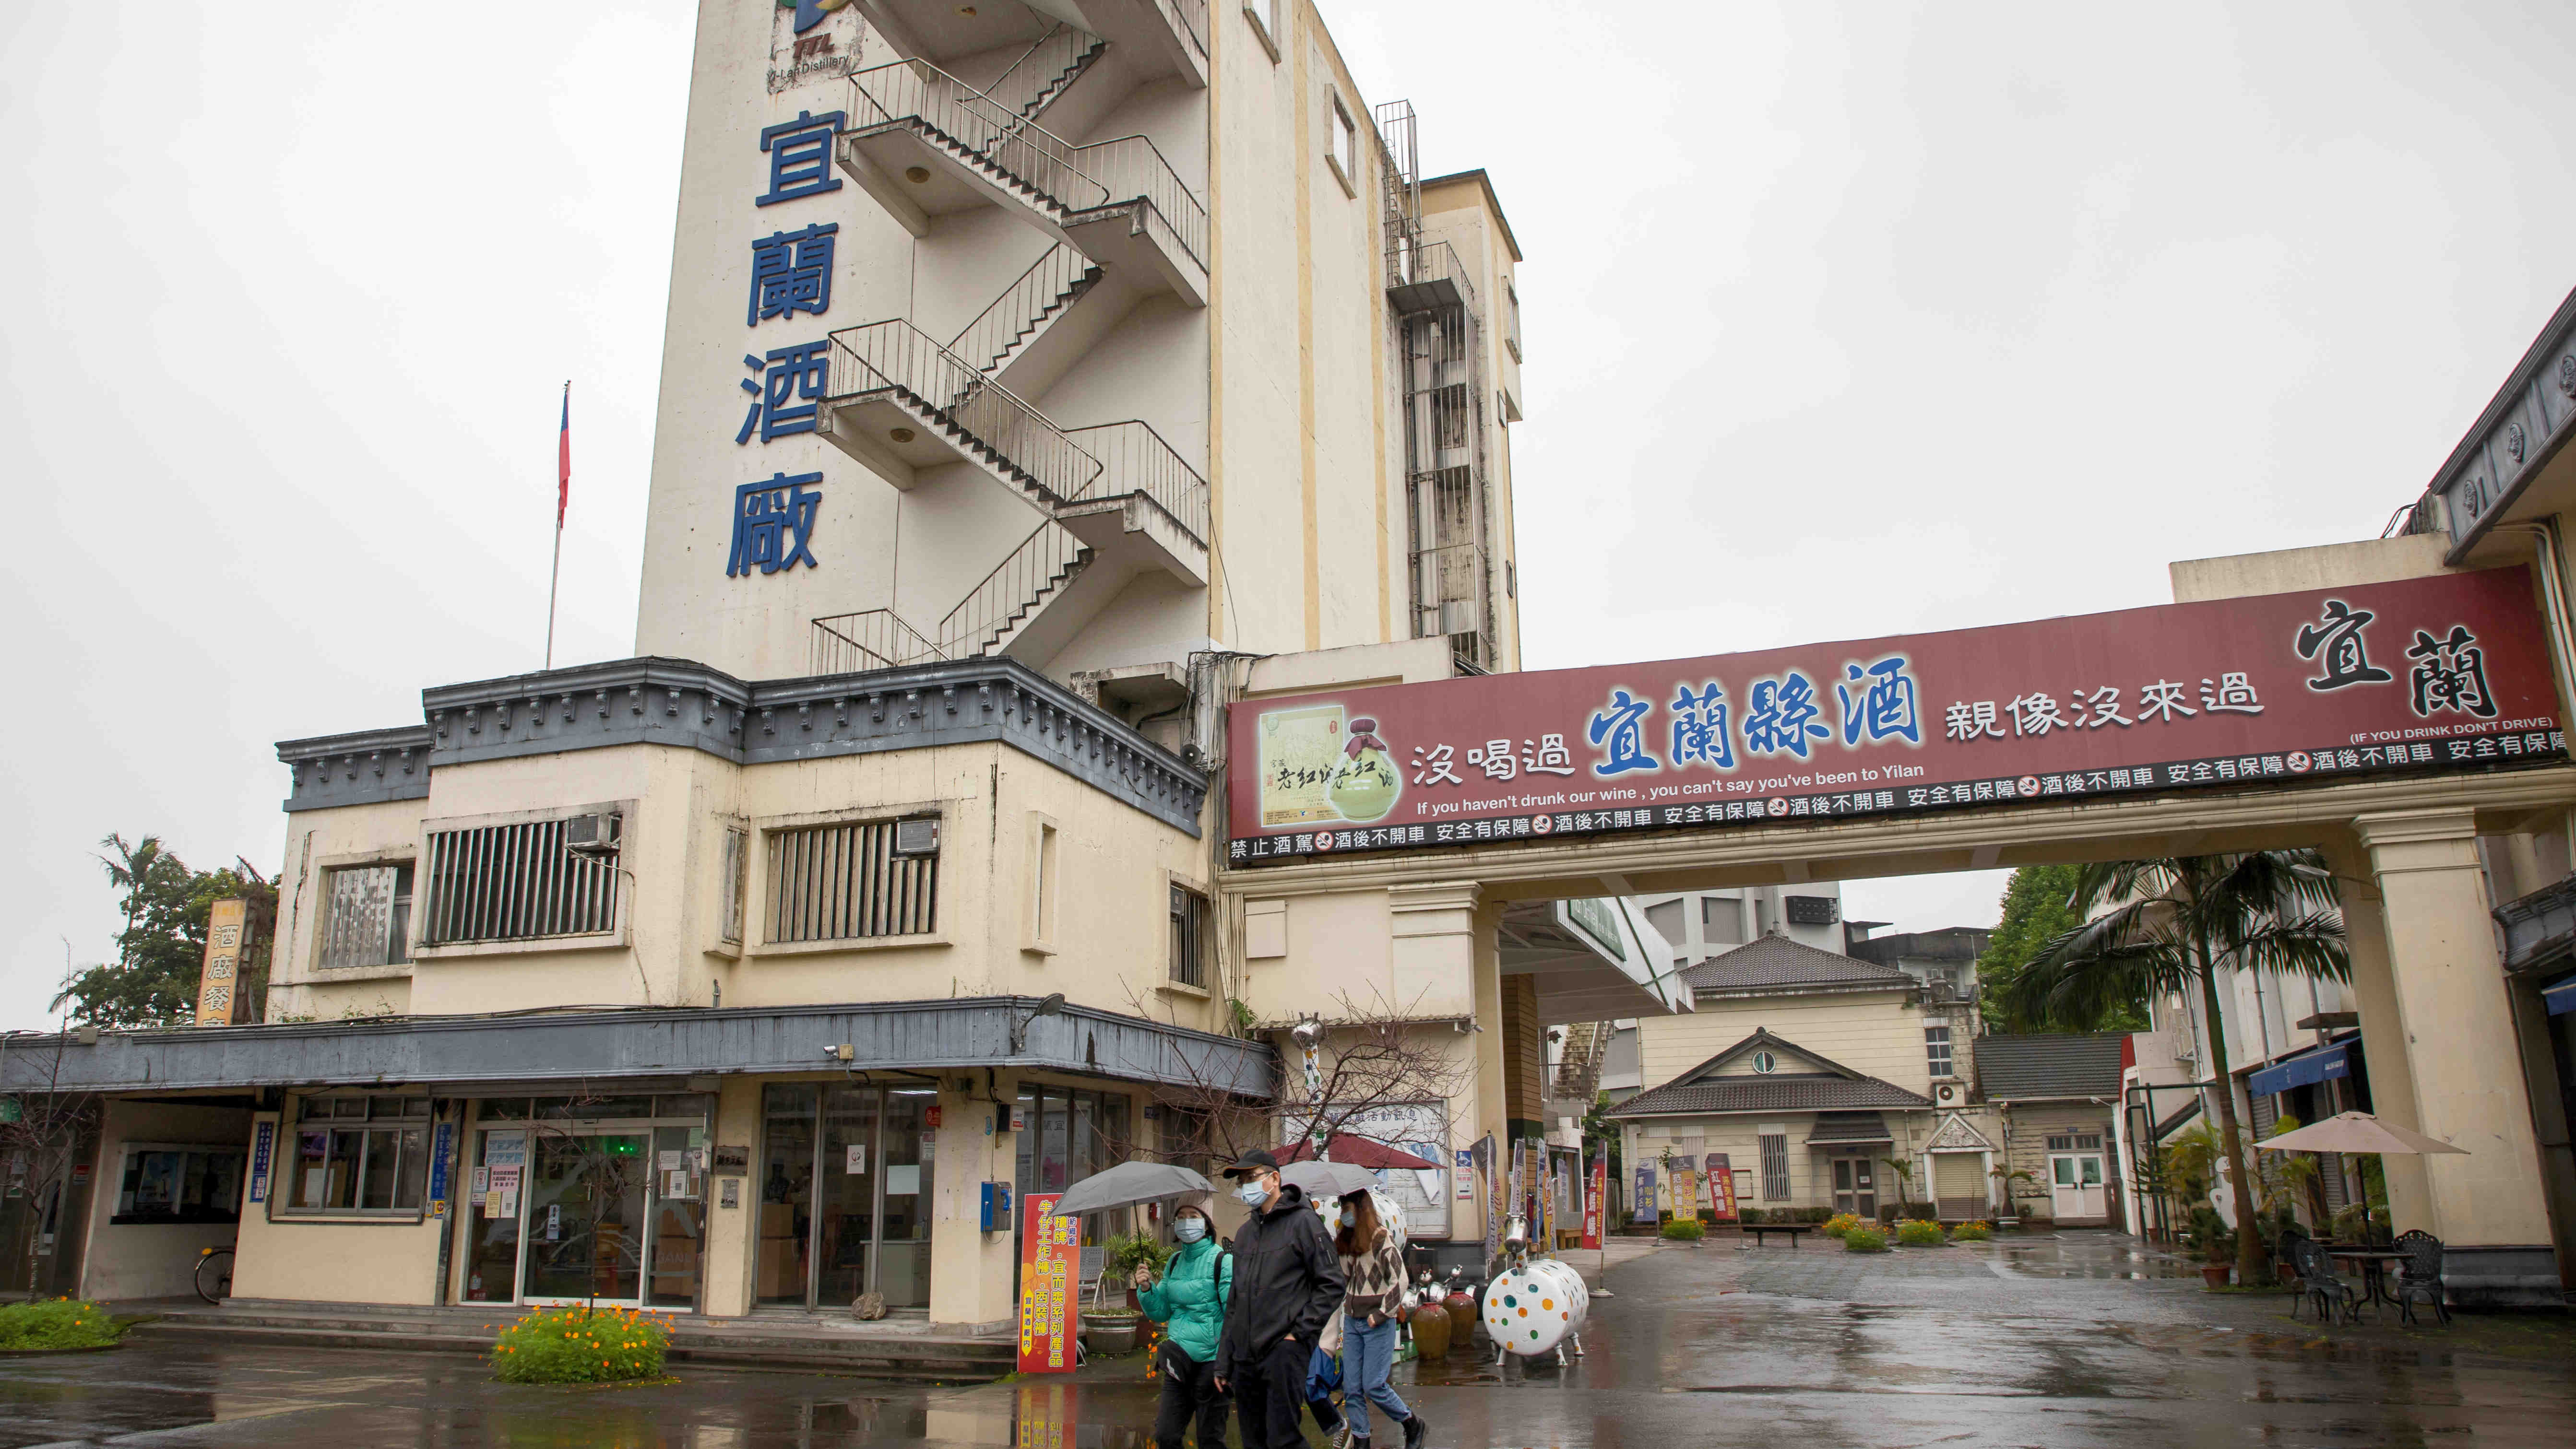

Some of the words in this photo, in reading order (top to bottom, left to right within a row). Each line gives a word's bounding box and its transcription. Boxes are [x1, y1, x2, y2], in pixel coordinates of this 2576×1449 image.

[793, 33, 835, 58] TTL
[802, 55, 849, 73] Distillery
[726, 110, 847, 577] 宜蘭酒廠
[2296, 601, 2498, 717] 宜蘭
[1589, 657, 1919, 775] 宜蘭縣酒
[2350, 733, 2367, 745] (IF
[2370, 730, 2400, 742] YOU
[2405, 726, 2451, 739] DRINK
[2454, 721, 2499, 735] DON'T
[2502, 717, 2553, 730] DRIVE)
[1231, 834, 1313, 858] 禁止酒駕
[1335, 825, 1425, 848] 酒後不開車
[1437, 817, 1531, 841] 安全有保障
[1555, 809, 1652, 832] 酒後不開車
[1665, 801, 1765, 825] 安全有保障
[1790, 791, 1895, 816] 酒後不開車
[1908, 779, 2016, 807] 安全有保障
[2042, 768, 2154, 795] 酒後不開車
[2168, 755, 2284, 783] 安全有保障
[2313, 743, 2434, 770] 酒後不開車
[2447, 731, 2567, 759] 安全有保障
[1417, 802, 1428, 815] If
[1432, 803, 1459, 817] you
[1463, 796, 1518, 811] haven't
[1520, 792, 1565, 807] drunk
[1569, 791, 1596, 803] our
[1600, 788, 1637, 801] wine
[1650, 785, 1678, 801] you
[1682, 780, 1723, 795] can't
[1727, 780, 1754, 794] say
[1758, 774, 1812, 793] you've
[1816, 771, 1857, 785] been
[1861, 768, 1878, 781] to
[1882, 764, 1924, 779] Yilan
